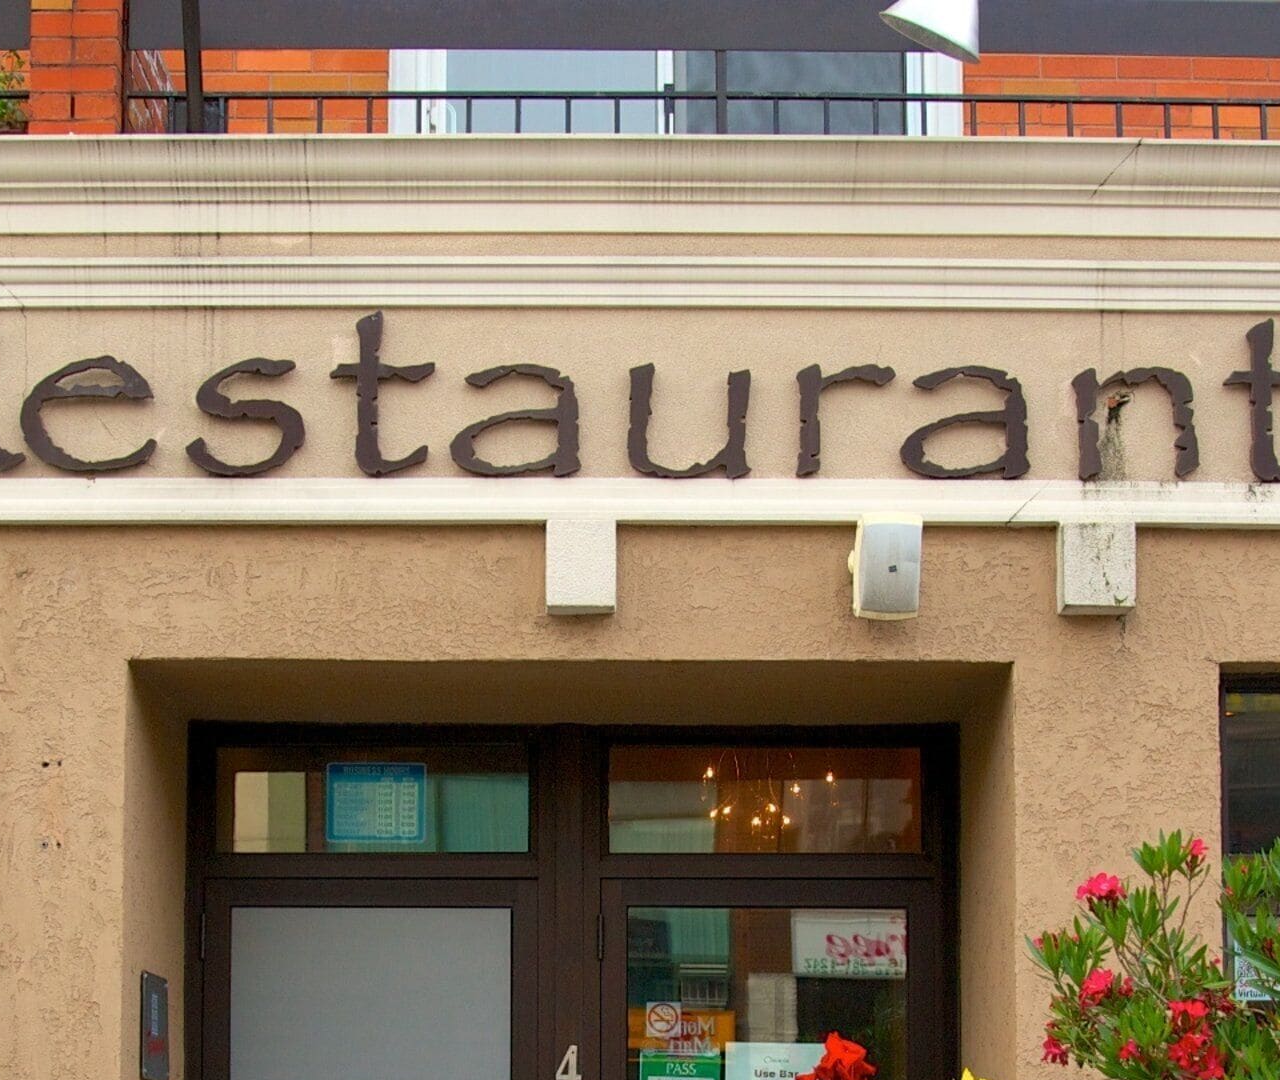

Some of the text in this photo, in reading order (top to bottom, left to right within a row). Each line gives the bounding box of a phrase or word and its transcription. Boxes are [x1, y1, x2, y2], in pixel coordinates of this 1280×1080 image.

[665, 1062, 697, 1076] PASS
[753, 1068, 800, 1079] Use Bar
